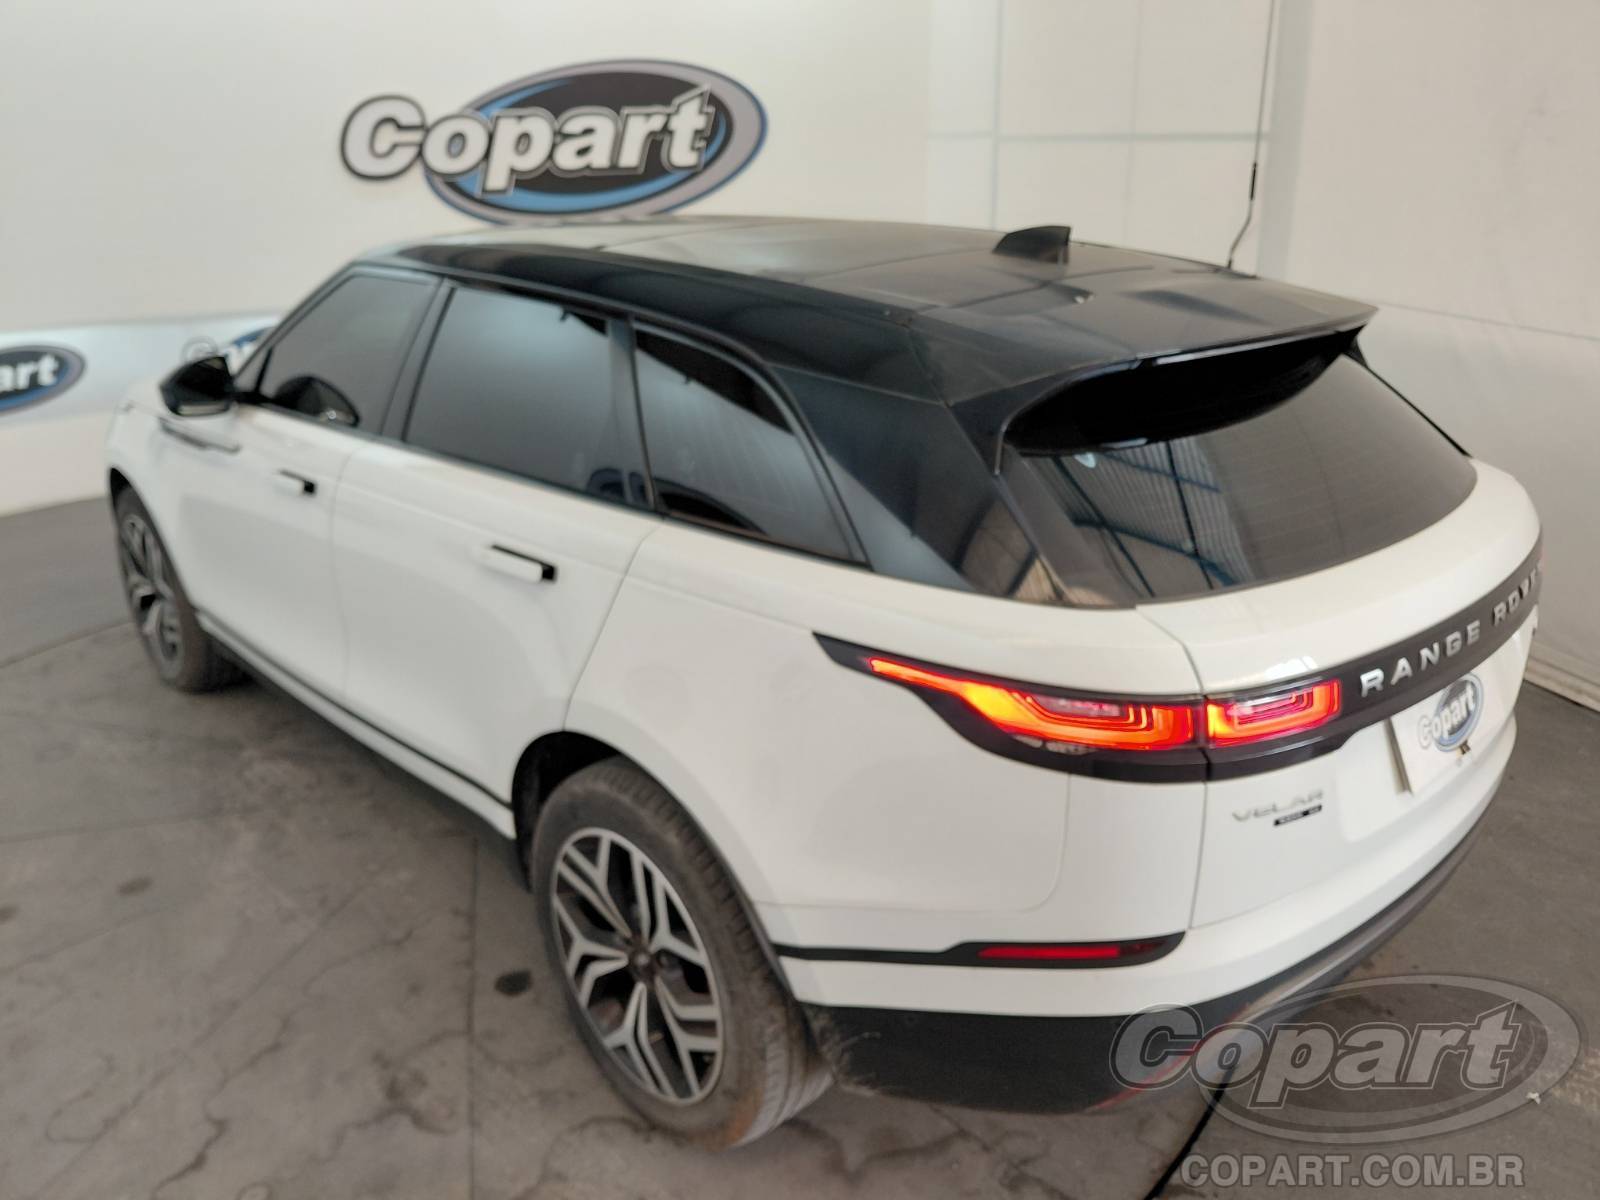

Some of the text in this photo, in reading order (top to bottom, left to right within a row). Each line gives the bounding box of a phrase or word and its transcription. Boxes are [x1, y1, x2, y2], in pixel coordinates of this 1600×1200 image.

[341, 86, 714, 195] Copart
[1360, 563, 1541, 698] RANGE ROV
[1417, 681, 1476, 750] Copart
